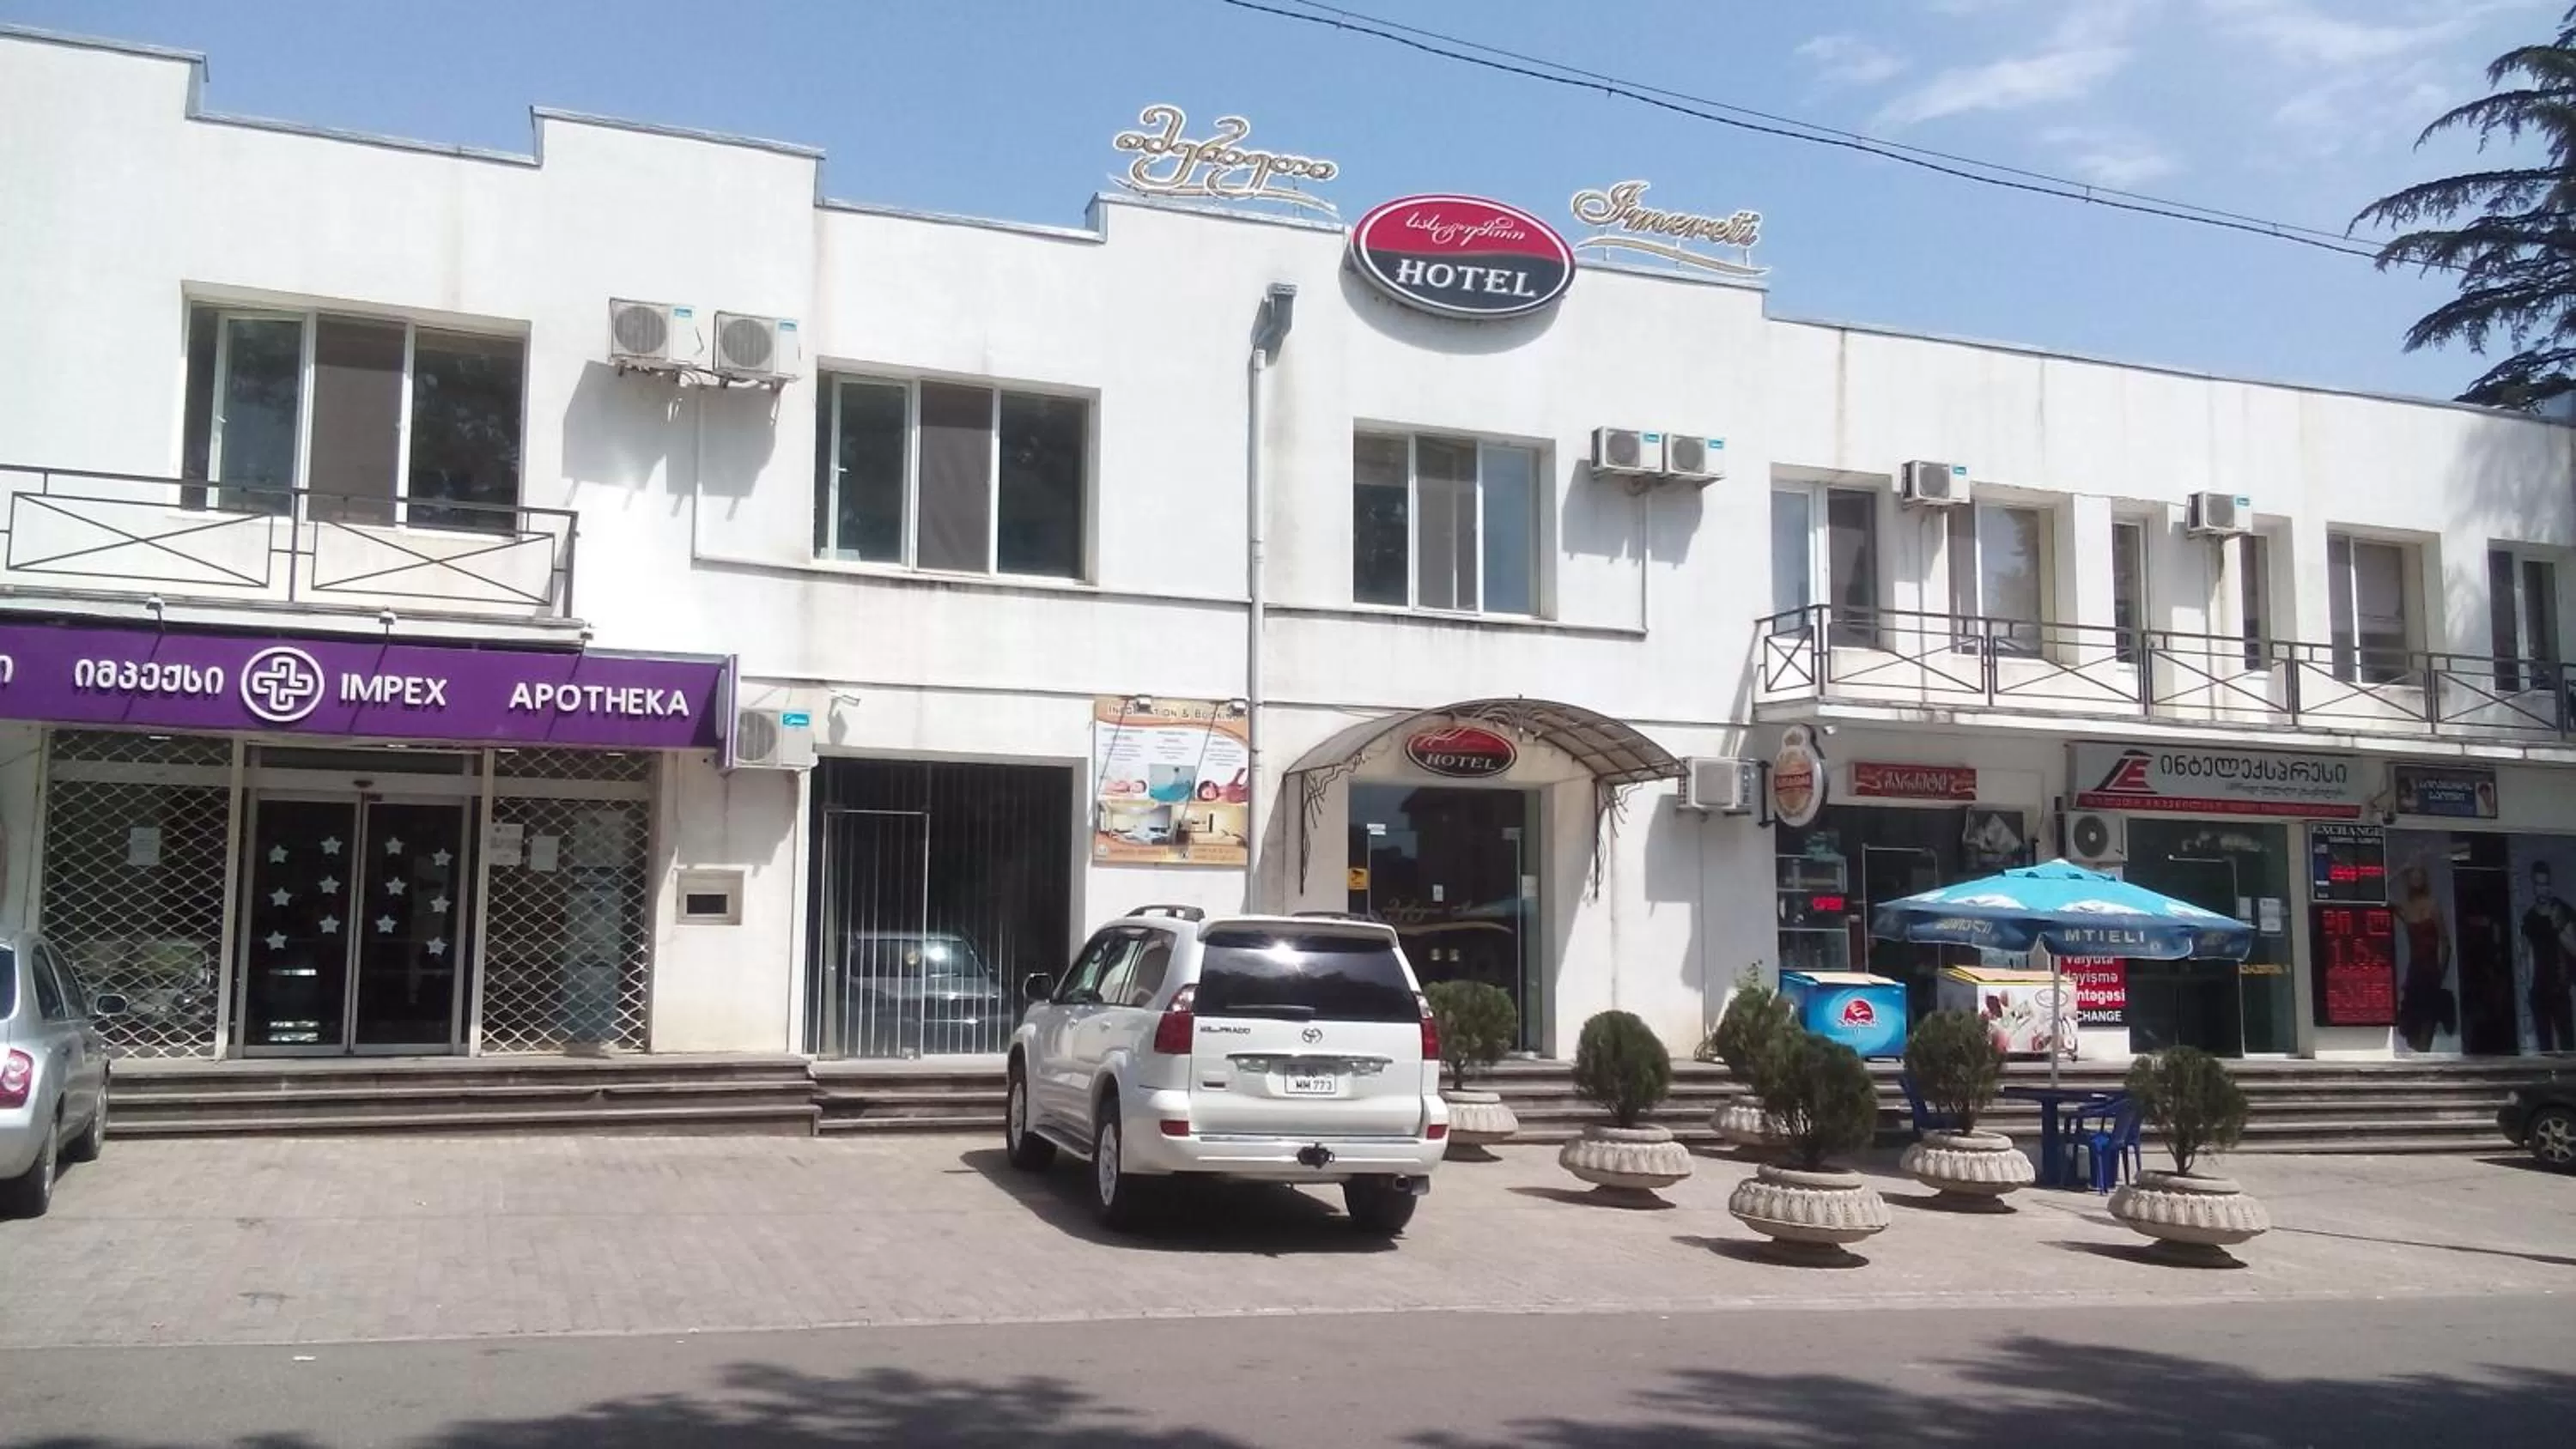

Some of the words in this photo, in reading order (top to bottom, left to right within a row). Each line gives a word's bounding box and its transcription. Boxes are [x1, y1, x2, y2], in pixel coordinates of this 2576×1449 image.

[1571, 179, 1763, 247] Imereti
[1396, 258, 1537, 298] HOTEL
[75, 658, 224, 694] იმპექსი
[340, 673, 447, 706] IMPEX
[508, 682, 690, 716] APOTHEKA
[1425, 754, 1498, 770] HOTEL
[2160, 755, 2348, 784] ინტელექსპრესი
[2312, 824, 2385, 837] EXCHANGE
[2065, 930, 2145, 943] MTIELI
[2076, 1010, 2123, 1022] CHANGE
